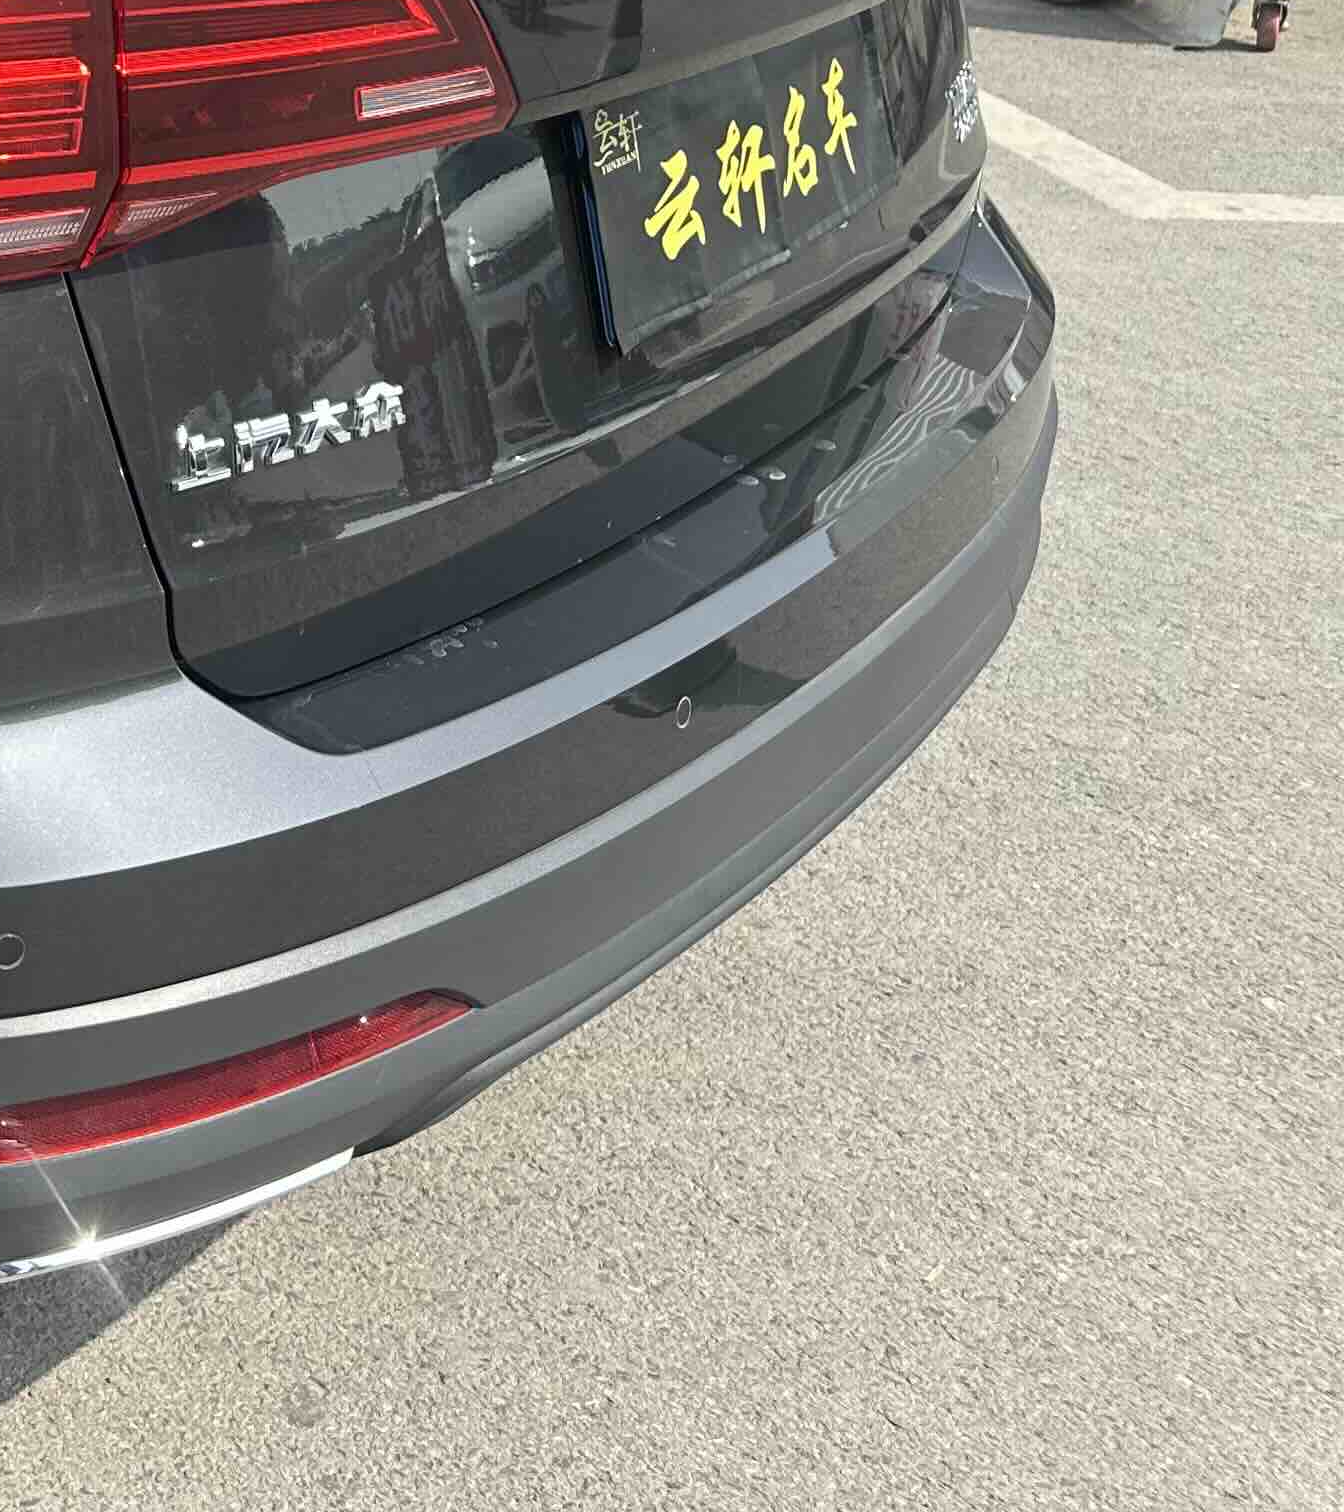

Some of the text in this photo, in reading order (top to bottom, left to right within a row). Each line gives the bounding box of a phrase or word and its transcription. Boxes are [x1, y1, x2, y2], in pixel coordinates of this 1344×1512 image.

[644, 57, 857, 261] 云轩名车
[171, 380, 407, 492] 上汽大众
